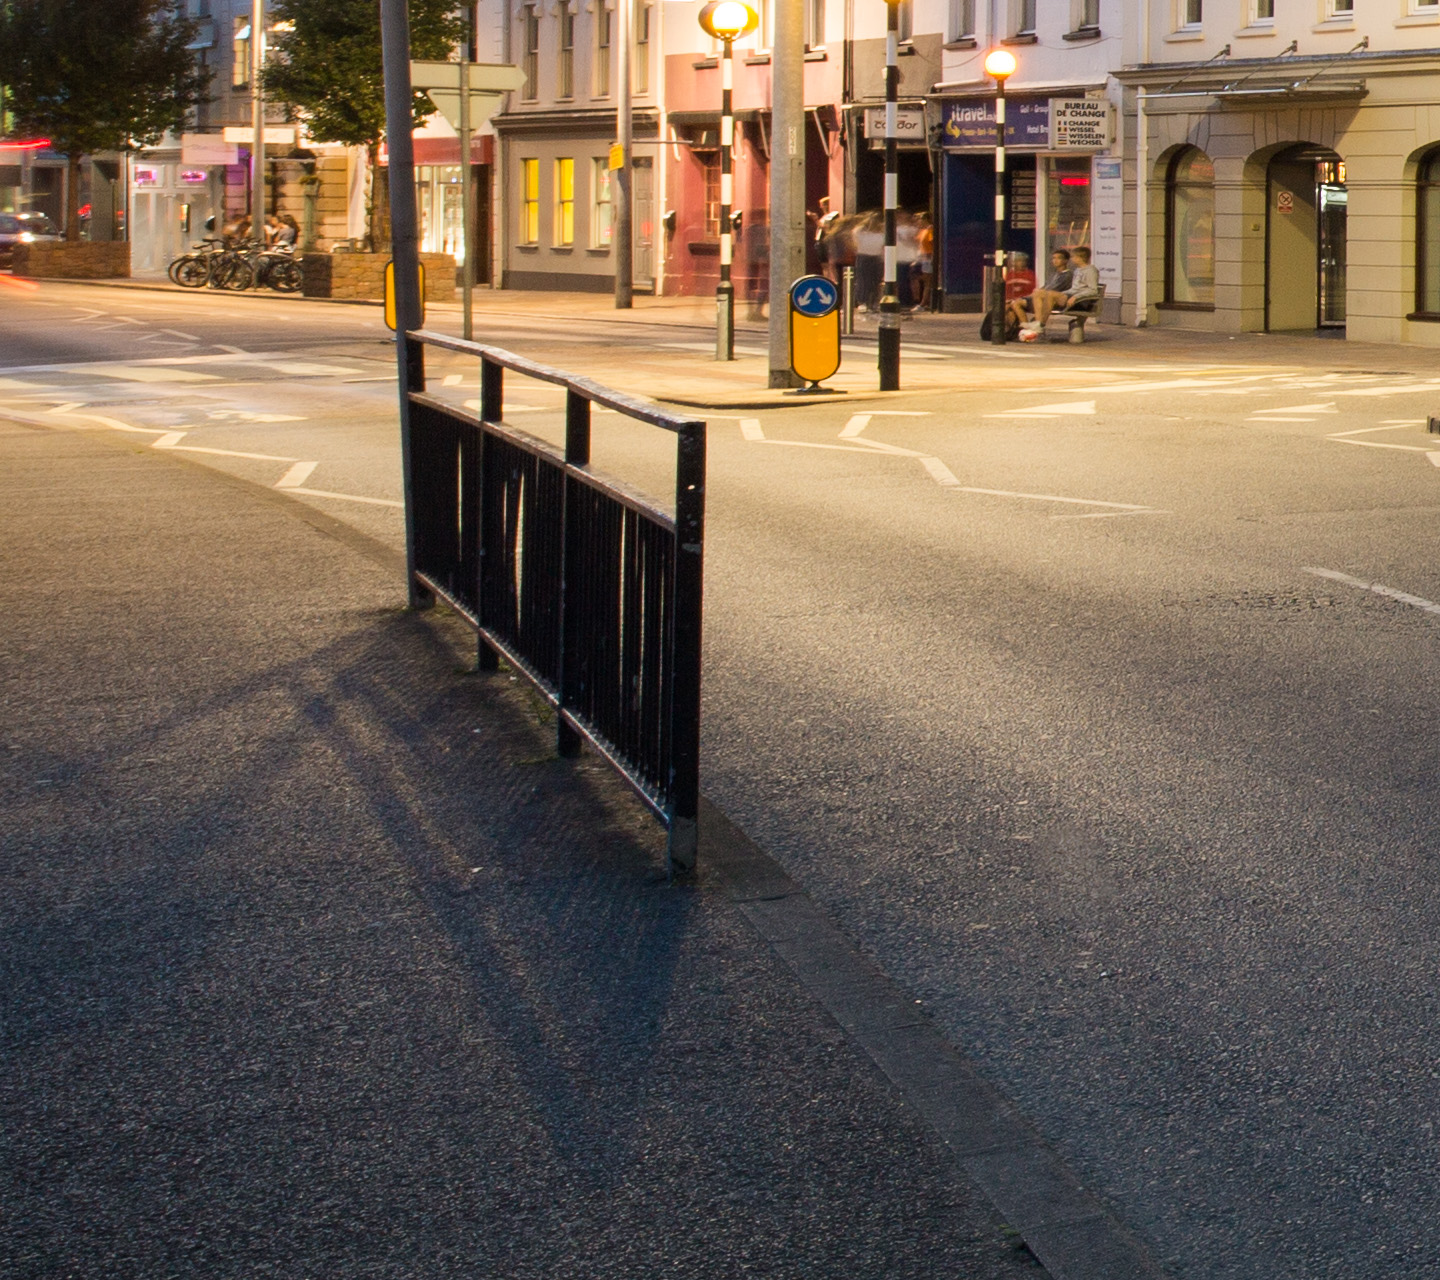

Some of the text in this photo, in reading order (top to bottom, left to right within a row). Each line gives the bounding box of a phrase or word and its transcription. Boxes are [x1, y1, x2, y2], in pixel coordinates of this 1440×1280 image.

[1064, 102, 1098, 110] BUREAU
[1070, 110, 1106, 118] CHANGE
[874, 120, 918, 130] codor
